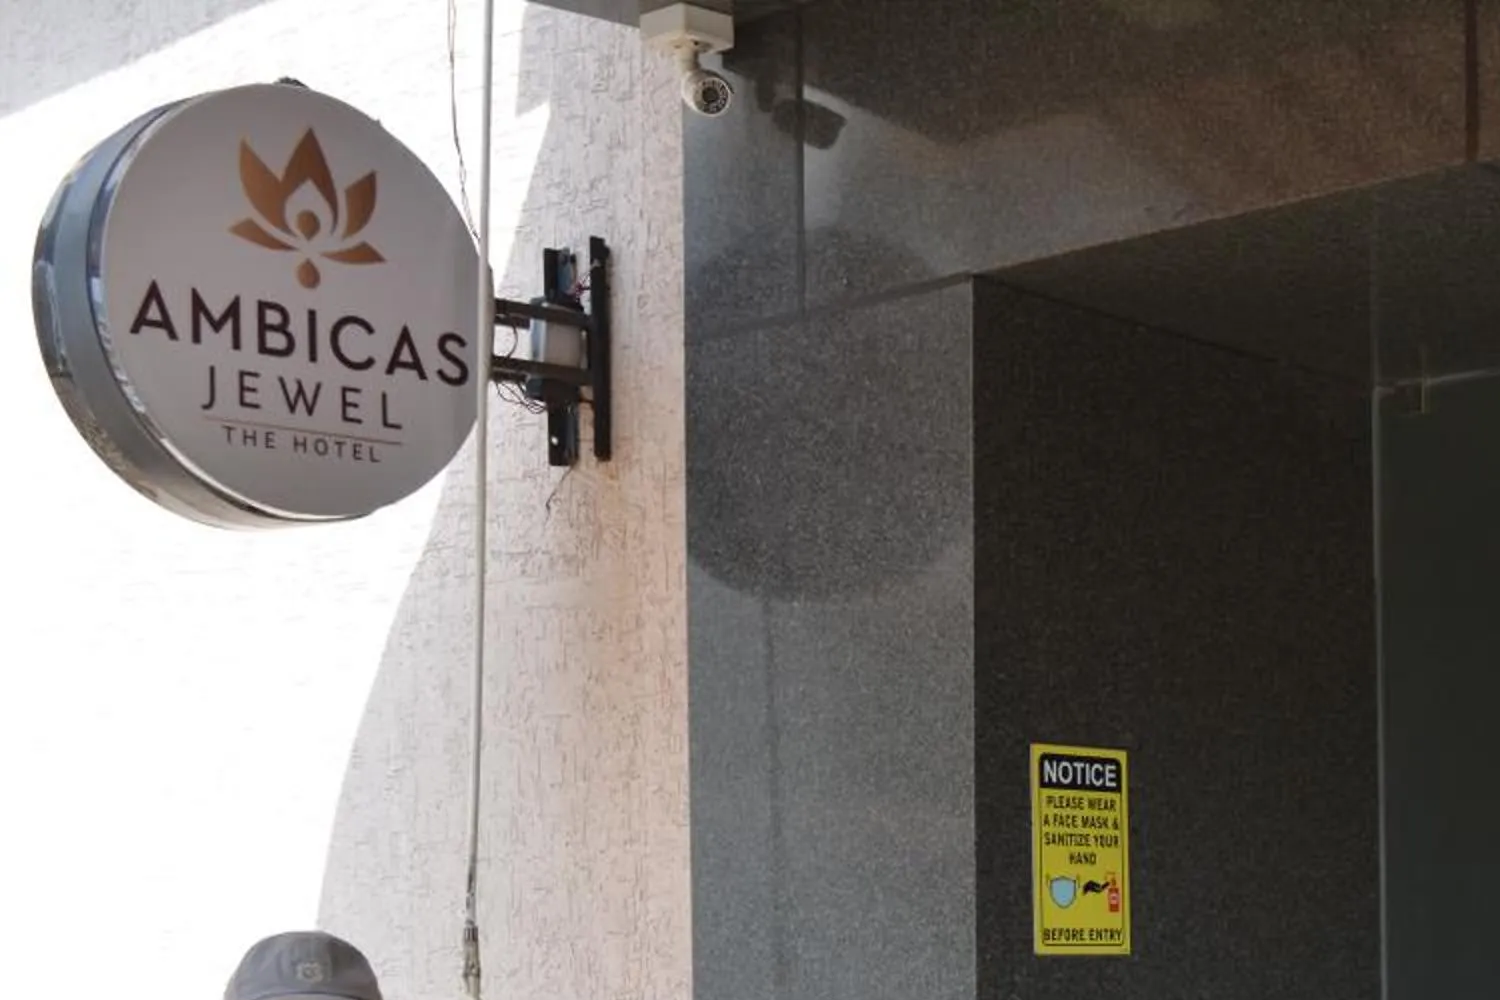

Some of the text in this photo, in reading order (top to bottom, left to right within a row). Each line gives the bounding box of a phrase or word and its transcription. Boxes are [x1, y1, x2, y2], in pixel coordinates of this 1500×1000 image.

[130, 280, 469, 387] AMBICAS
[202, 365, 403, 430] JEWEL
[223, 425, 381, 463] THE HOTEL
[1043, 759, 1117, 787] NOTICE
[1045, 795, 1117, 812] PLEASE WEAR
[1043, 813, 1050, 827] A
[1053, 813, 1078, 828] FACE
[1081, 815, 1109, 829] MASK
[1044, 831, 1119, 848] SANITIZE YOUR
[1069, 852, 1097, 865] HAND
[1043, 927, 1122, 942] BEFORE ENTRY
